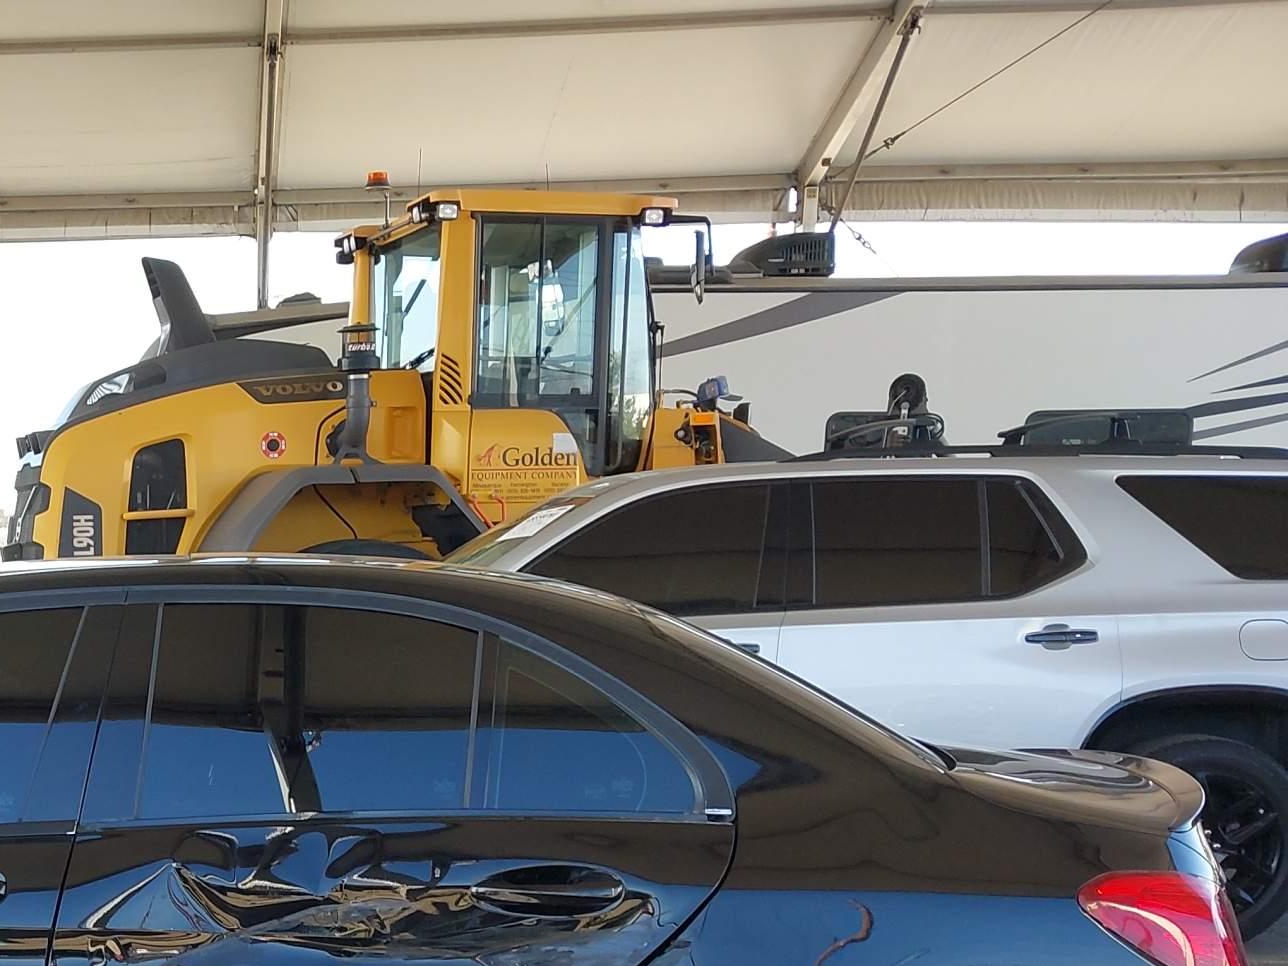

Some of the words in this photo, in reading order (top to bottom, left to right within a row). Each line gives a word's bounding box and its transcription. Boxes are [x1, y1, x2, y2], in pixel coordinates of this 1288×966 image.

[255, 381, 344, 396] VOLVO
[502, 447, 577, 467] Golden
[472, 472, 528, 481] EQUIPMENT
[73, 515, 94, 556] L90H
